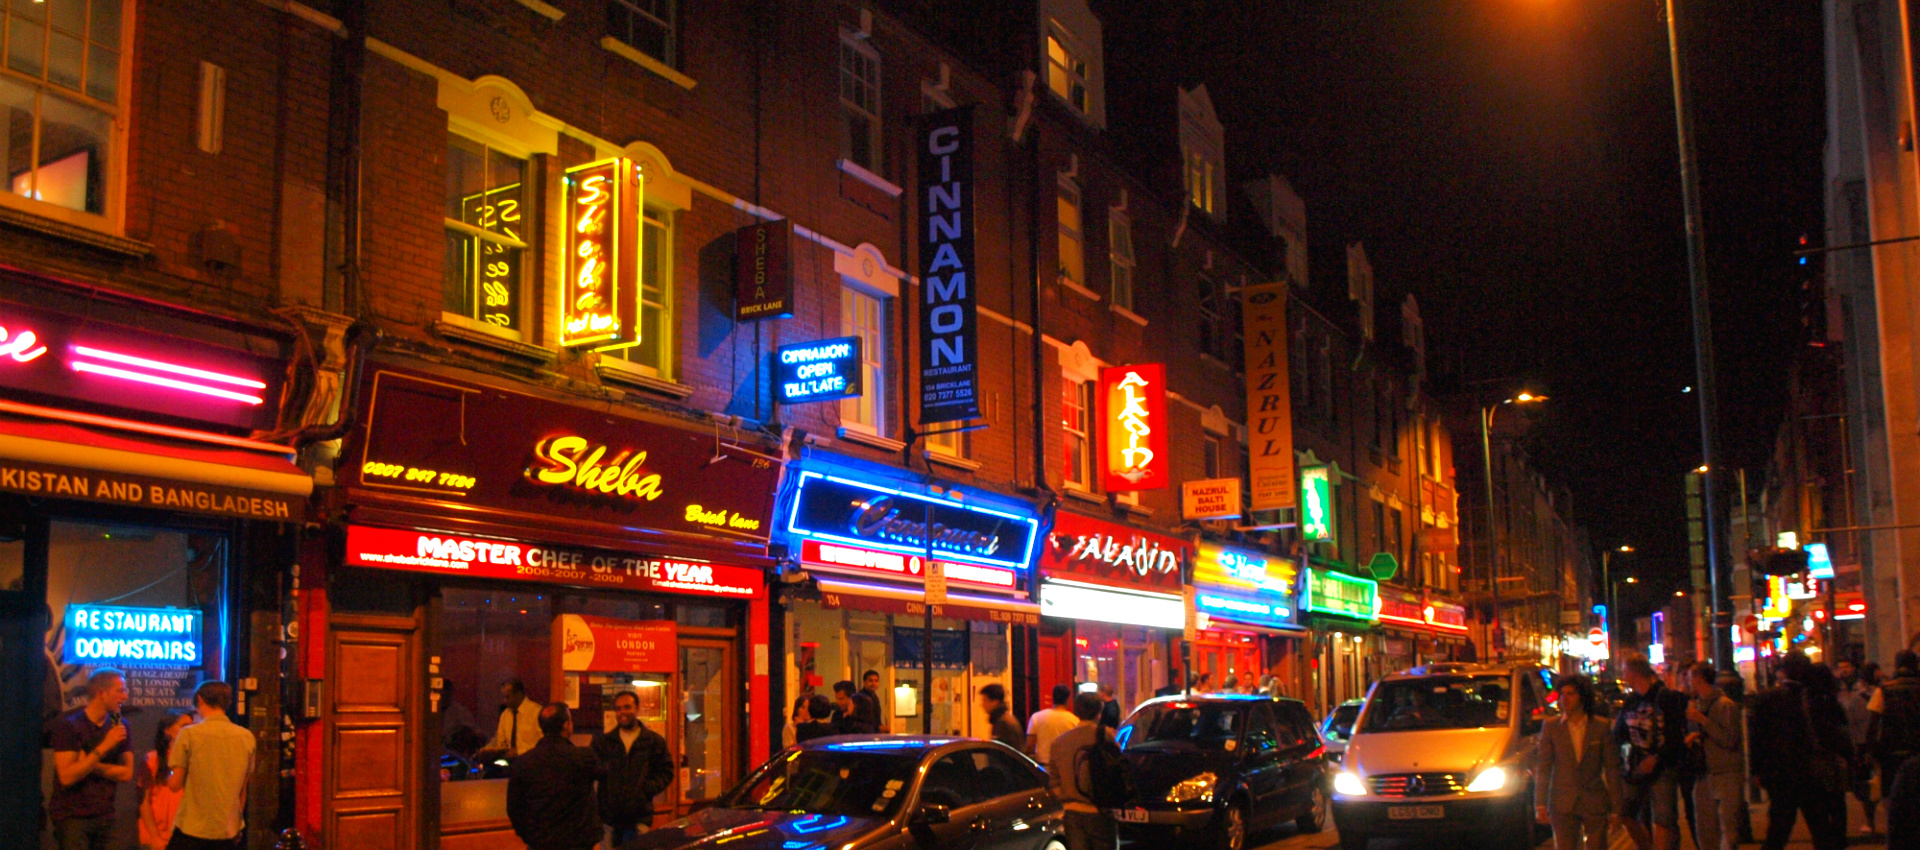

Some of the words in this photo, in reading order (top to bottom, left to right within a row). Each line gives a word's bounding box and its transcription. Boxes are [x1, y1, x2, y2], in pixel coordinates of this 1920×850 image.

[926, 125, 967, 367] CINNAMON
[754, 228, 766, 299] SHEBA
[740, 303, 762, 315] BRICK
[763, 300, 783, 311] LANE
[781, 343, 851, 365] CINNAMON
[797, 362, 835, 380] OPEN
[923, 363, 972, 376] RESTAURANT
[1255, 328, 1281, 457] NAZRUL
[363, 461, 404, 479] 0207
[536, 435, 663, 501] Sheba
[752, 458, 771, 469] 136
[96, 478, 143, 502] AND
[150, 485, 289, 518] BANGLADESH
[1192, 486, 1229, 496] NAZRUL
[1197, 496, 1224, 504] BALTI
[685, 504, 728, 526] Brick
[1195, 504, 1227, 513] HOUSE
[416, 535, 522, 566] MASTER
[526, 548, 583, 570] CHEF
[591, 555, 618, 574] OF
[622, 558, 661, 579] THE
[664, 561, 714, 584] YEAR
[906, 602, 943, 616] CINNAON
[75, 609, 194, 633] RESTAURANT
[75, 637, 196, 661] DOWNSTAIRS
[616, 639, 655, 651] LONDON
[122, 662, 190, 671] RECOMMENDED
[131, 670, 189, 679] BANGLADESHI
[132, 679, 142, 687] IN
[145, 679, 181, 687] LONDON
[145, 688, 176, 696] SEATS
